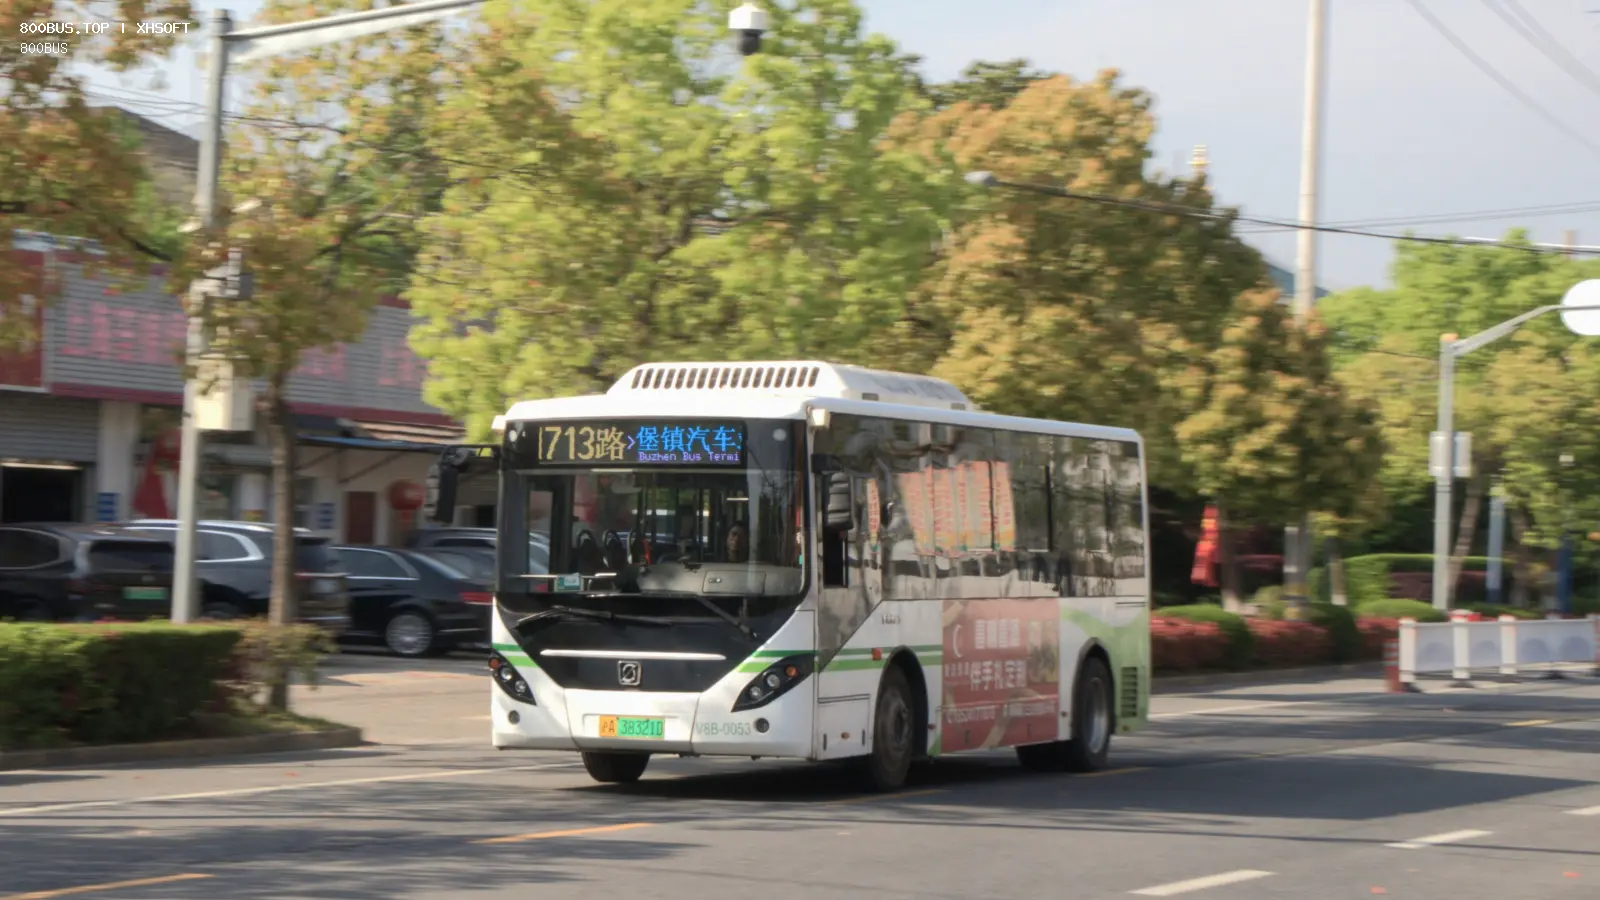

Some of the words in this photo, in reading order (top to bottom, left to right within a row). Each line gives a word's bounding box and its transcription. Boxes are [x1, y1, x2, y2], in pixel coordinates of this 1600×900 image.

[636, 425, 743, 453] 堡镇汽车
[638, 451, 677, 462] Buzhen
[682, 451, 702, 462] Bus
